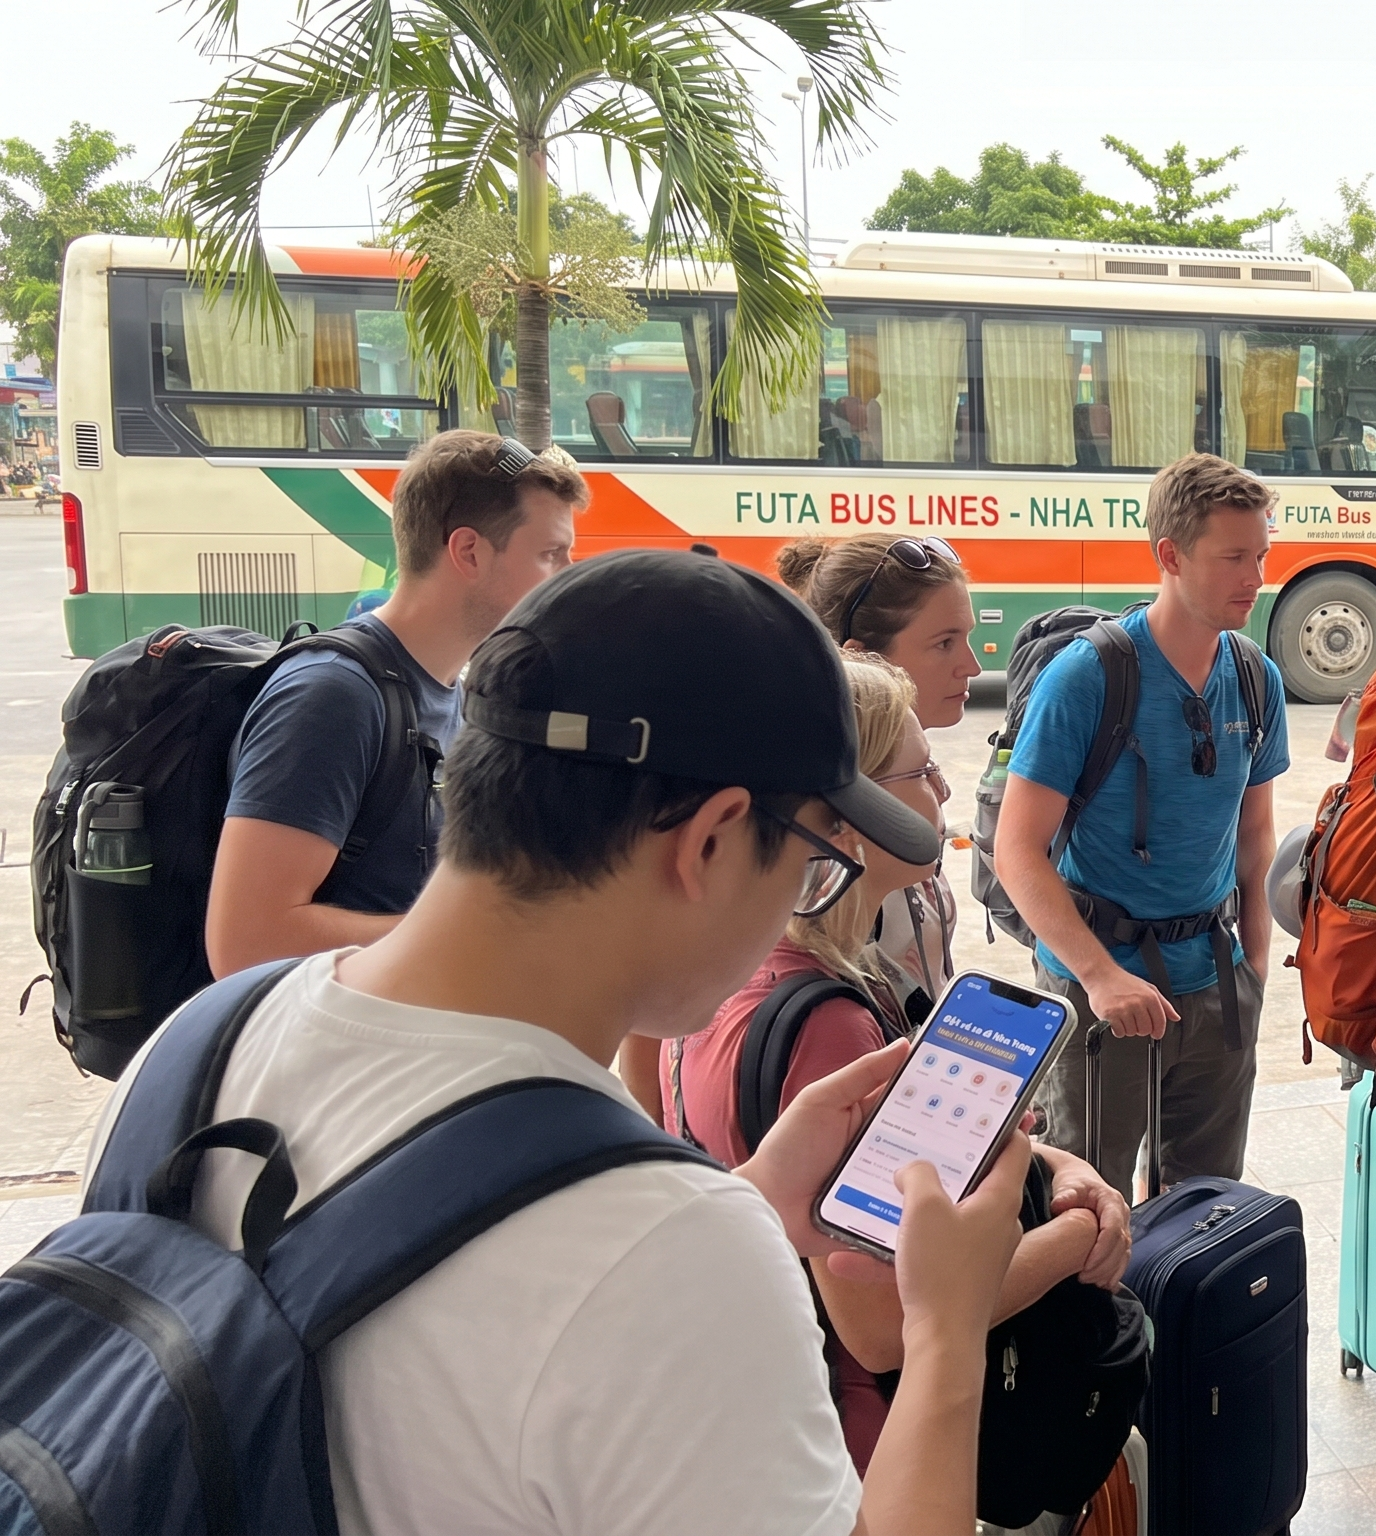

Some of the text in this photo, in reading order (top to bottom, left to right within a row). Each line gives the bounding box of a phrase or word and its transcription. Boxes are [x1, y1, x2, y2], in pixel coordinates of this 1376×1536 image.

[736, 492, 820, 524] FUTA
[830, 493, 896, 525] BUS
[908, 495, 1000, 527] LINES
[1030, 497, 1094, 528] NHA
[1103, 498, 1147, 528] TR
[1285, 506, 1332, 524] FUTA
[1337, 507, 1371, 524] Bus
